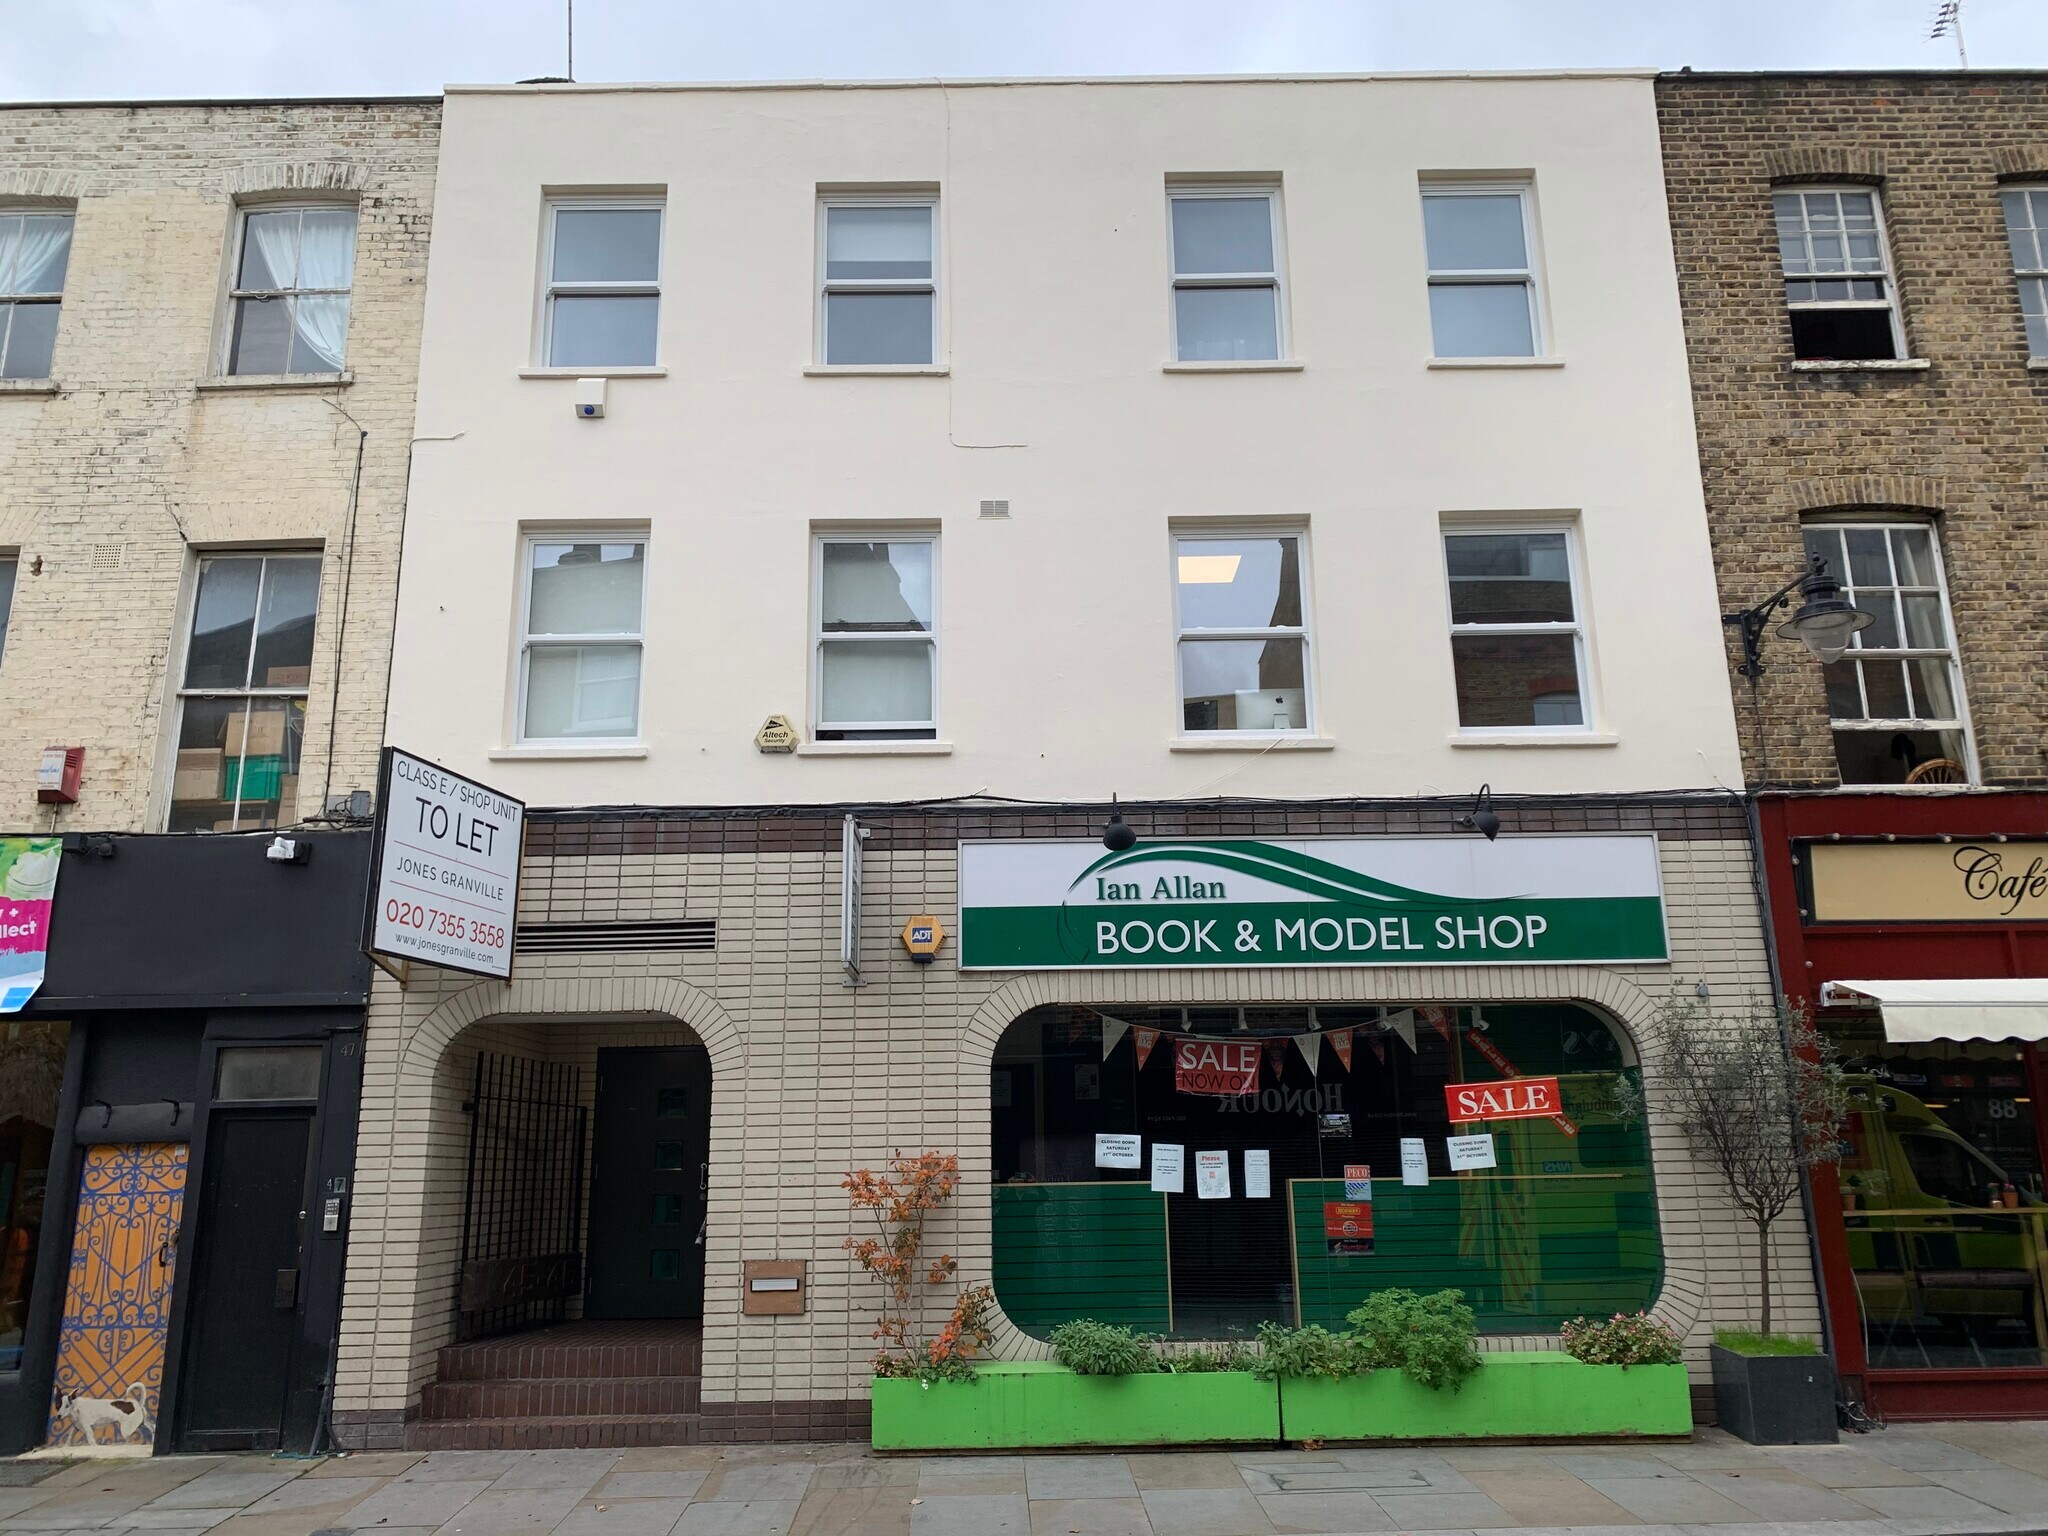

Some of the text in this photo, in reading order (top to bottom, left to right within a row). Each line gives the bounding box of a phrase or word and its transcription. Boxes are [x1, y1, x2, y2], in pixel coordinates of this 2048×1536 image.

[762, 731, 789, 739] Altech
[397, 760, 519, 822] CLASS E / SHOP UNIT
[415, 796, 500, 857] TO LET
[397, 856, 504, 902] JONES GRANVILLE
[1095, 874, 1227, 900] Ian Allan
[1953, 846, 2048, 915] Café
[0, 920, 37, 939] llect
[386, 898, 505, 949] 020 7355 3558
[912, 927, 933, 941] ADT
[1096, 915, 1548, 955] BOOK & MODEL SHOP
[395, 932, 494, 964] www.jonesgranville.com
[1182, 1043, 1256, 1072] SALE
[1182, 1072, 1225, 1089] NOW
[1458, 1085, 1550, 1116] SALE
[1346, 1167, 1367, 1178] PECO
